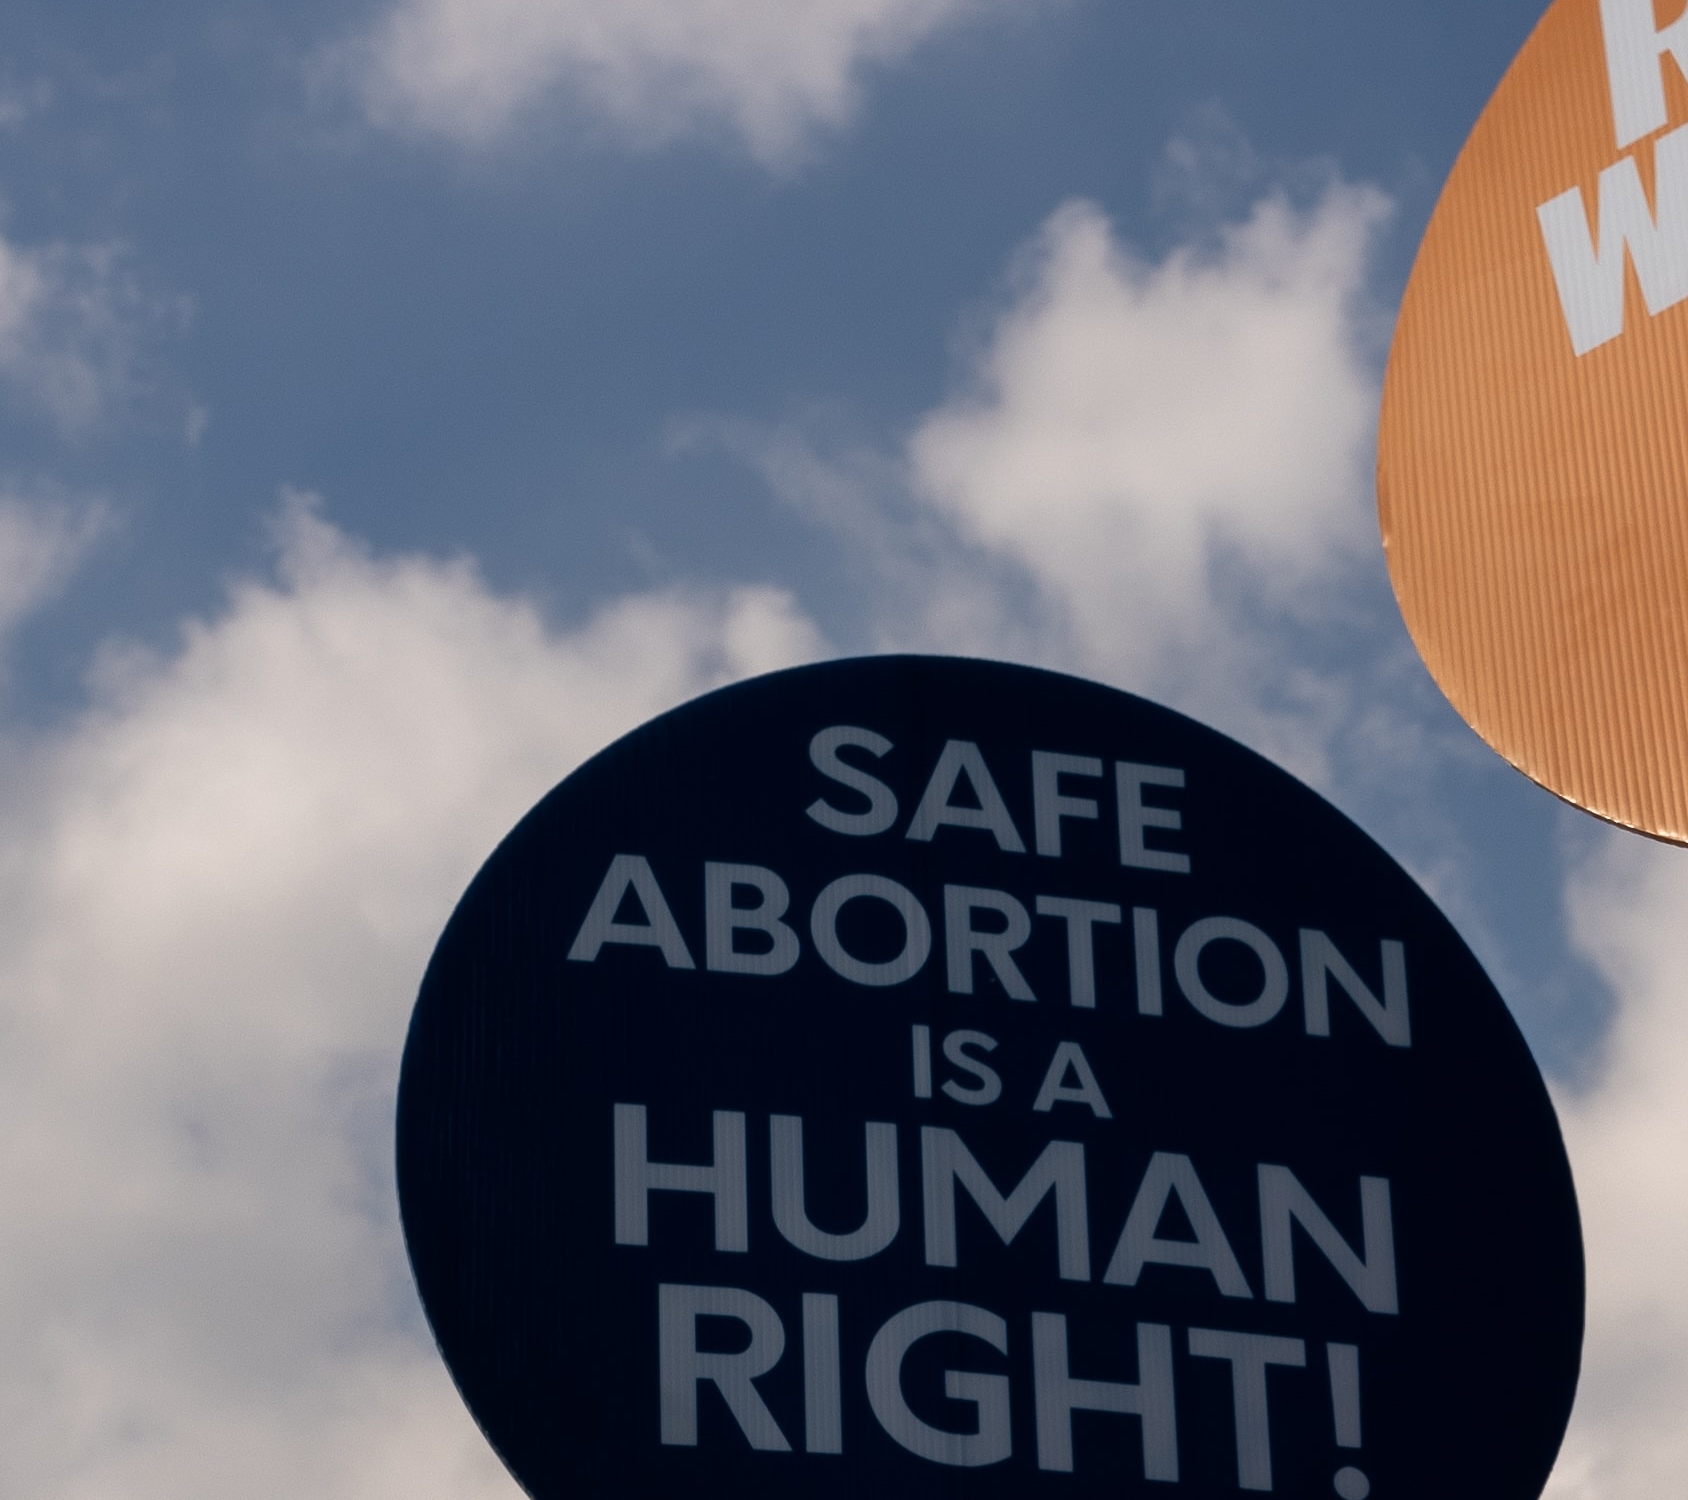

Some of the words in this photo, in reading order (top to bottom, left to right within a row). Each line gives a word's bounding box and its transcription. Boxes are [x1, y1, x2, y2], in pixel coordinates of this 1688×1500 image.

[805, 724, 1192, 875] SAFE
[565, 853, 1413, 1048] ABORTION
[911, 1024, 1003, 1106] IS
[1032, 1040, 1113, 1120] A
[612, 1102, 1400, 1316] HUMAN
